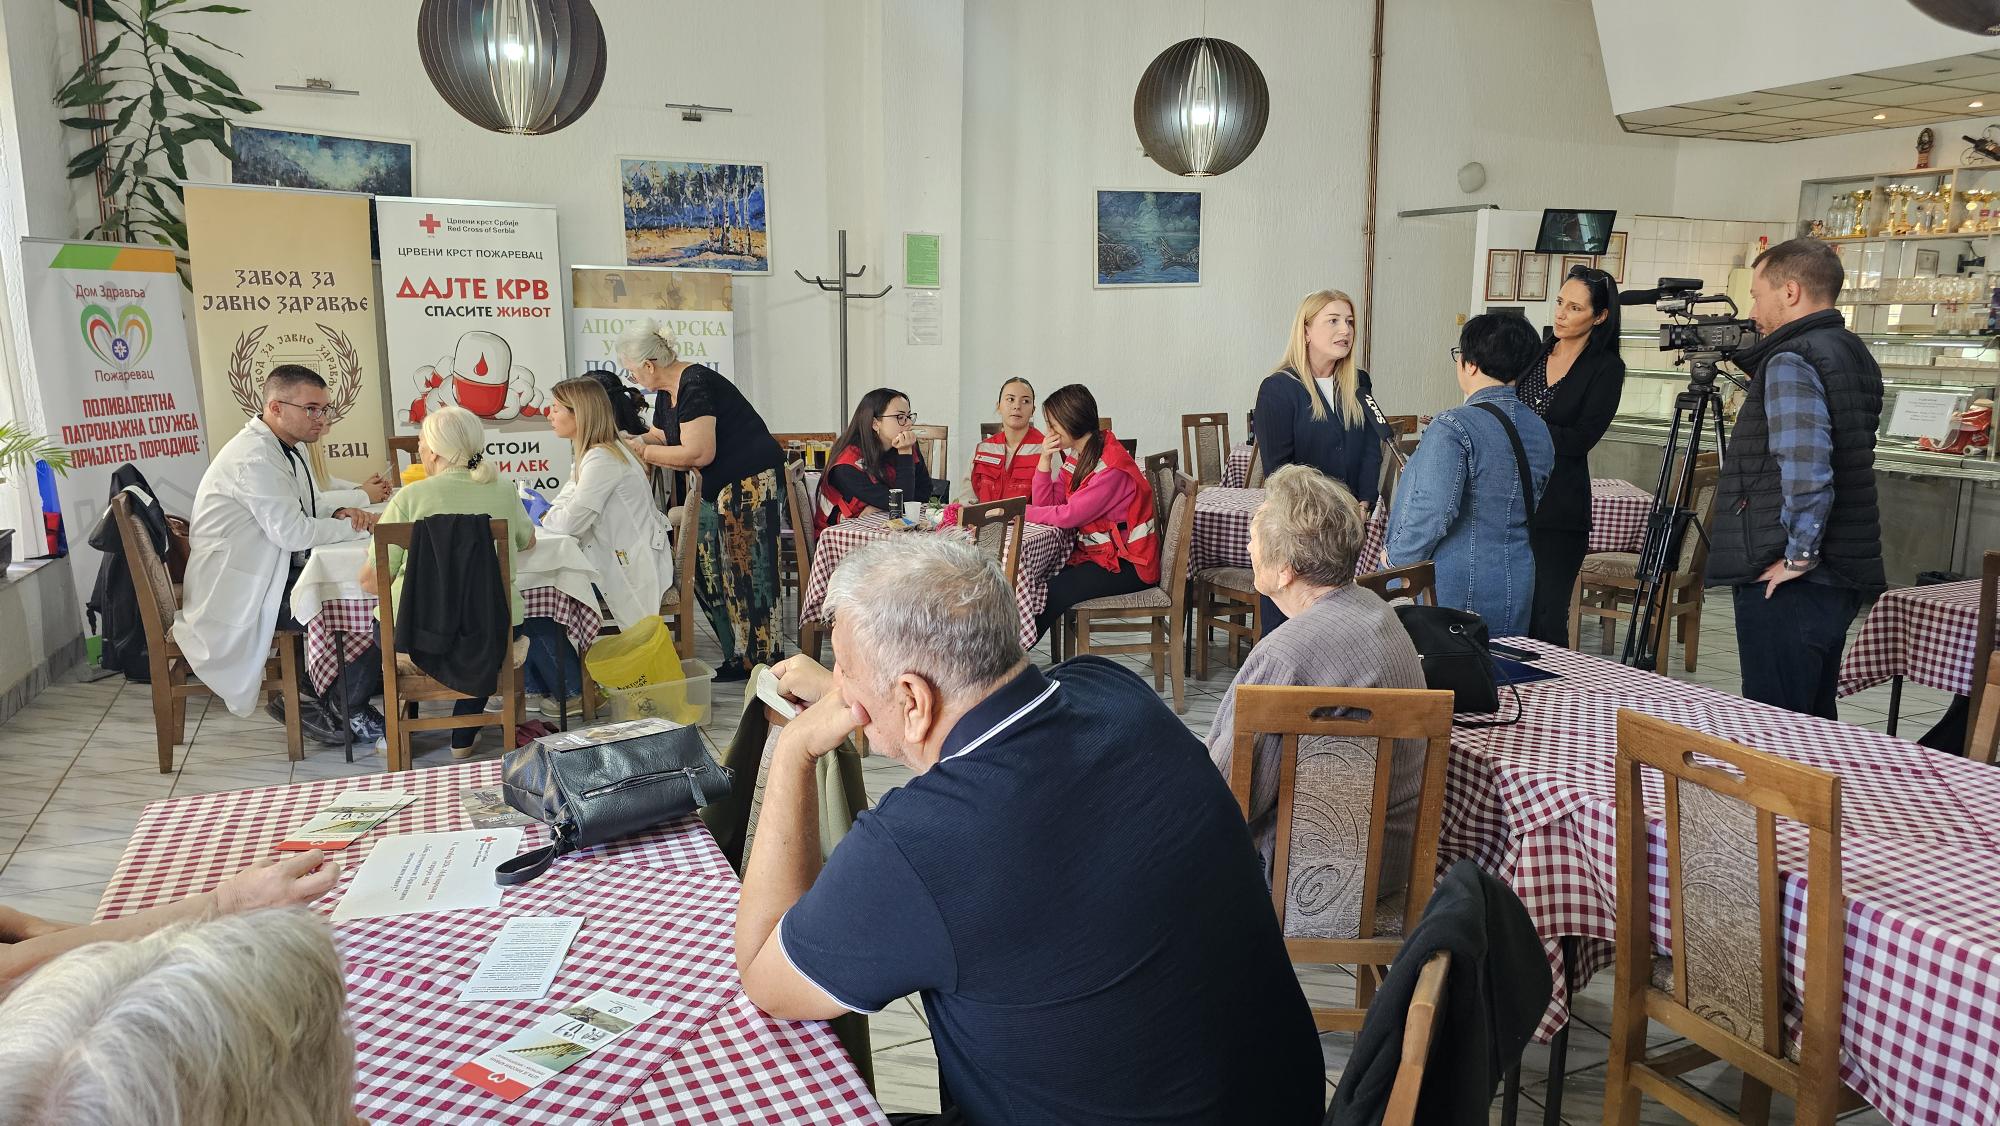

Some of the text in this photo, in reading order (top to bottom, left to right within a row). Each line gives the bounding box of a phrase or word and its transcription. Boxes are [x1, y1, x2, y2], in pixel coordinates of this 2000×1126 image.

[447, 224, 461, 232] Red
[462, 225, 484, 233] Cross
[492, 226, 516, 234] Serbia
[398, 247, 544, 261] ЦРВЕНИ КРСТ ПОЖАРЕВАЦ
[234, 269, 336, 289] ЗАВОД ЗА
[395, 275, 549, 300] ДАЈТЕ КРВ
[75, 284, 146, 301] Дом Здравља
[202, 294, 368, 315] ЈАВНО ЗДРАВЉЕ
[424, 305, 552, 318] СПАСИТЕ ЖИВОТ
[94, 370, 155, 384] Пожаревац
[82, 392, 176, 419] ПОЛИВАЛЕНТНА
[61, 413, 199, 445] ПАТРОНАЖНА СЛУЖБА
[70, 434, 200, 469] ПРИЈАТЕЉ ПОРОДИЦЕ
[515, 459, 550, 473] ЛЕК
